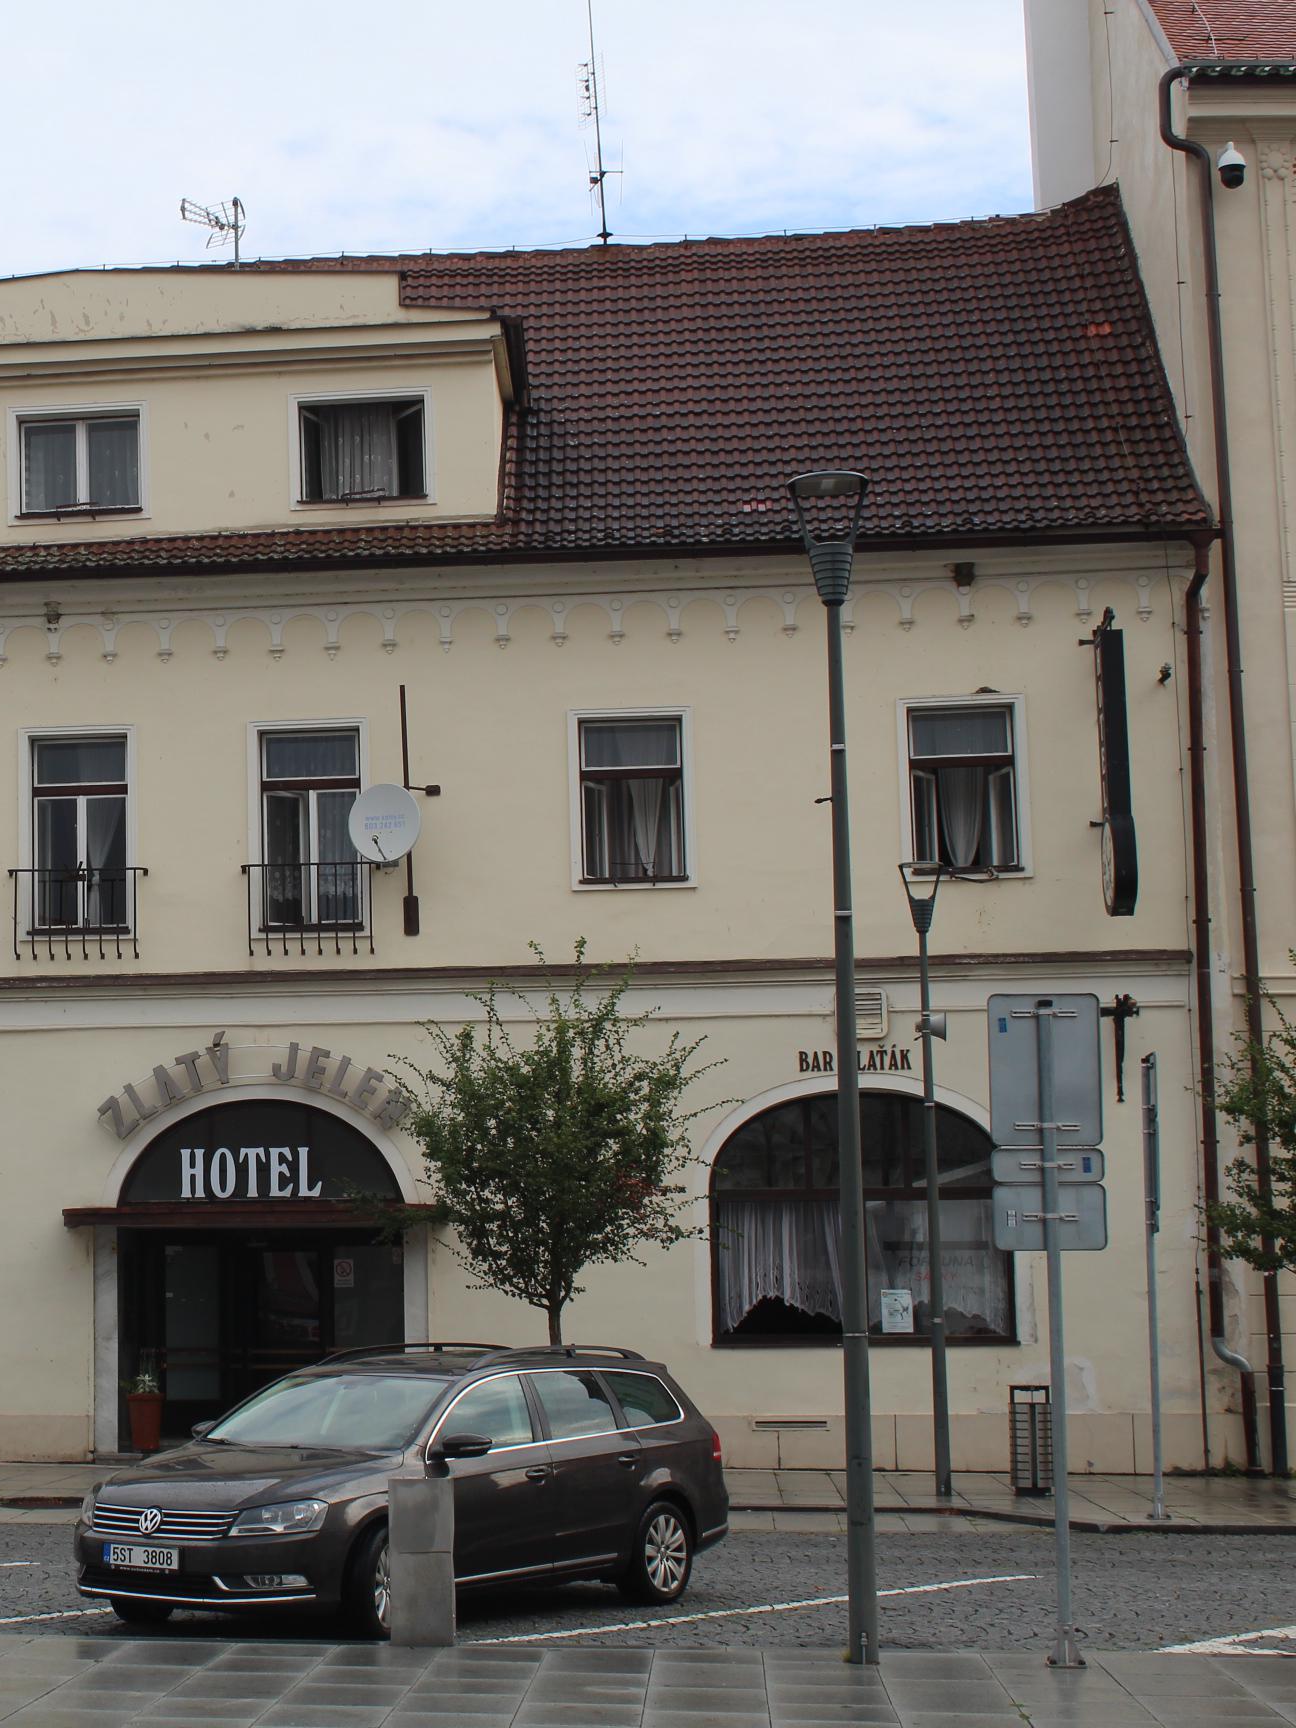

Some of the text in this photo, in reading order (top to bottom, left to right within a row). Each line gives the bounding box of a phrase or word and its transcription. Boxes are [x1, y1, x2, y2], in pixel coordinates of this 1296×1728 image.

[798, 1044, 912, 1072] BAR LAŤÁK
[96, 1031, 230, 1140] ZLATÝ
[180, 1146, 323, 1199] HOTEL
[112, 1546, 134, 1564] 5ST
[143, 1549, 173, 1567] 3808
